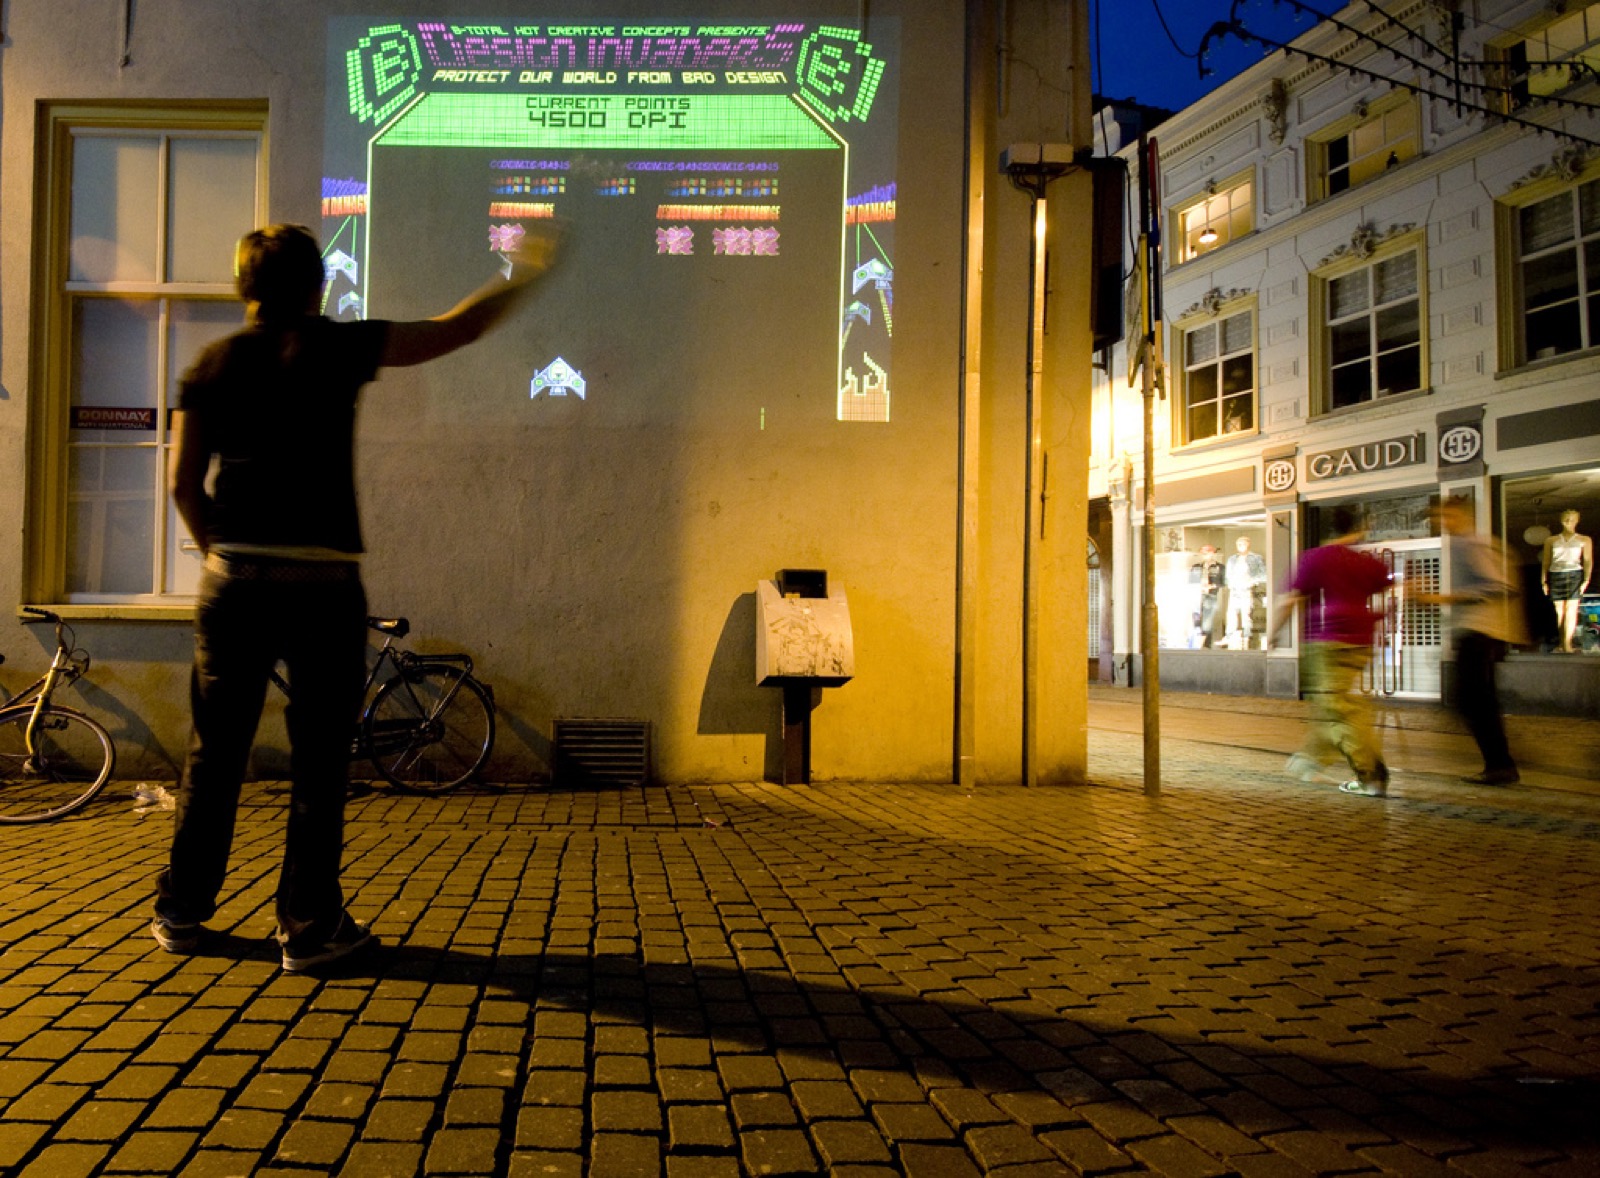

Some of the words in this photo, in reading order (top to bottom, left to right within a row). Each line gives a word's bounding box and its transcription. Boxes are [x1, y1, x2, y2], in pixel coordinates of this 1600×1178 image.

[514, 25, 540, 36] HOT
[547, 25, 615, 36] CREATIVE
[622, 26, 692, 36] CONCEPTS
[432, 69, 511, 83] PROTECT
[519, 70, 553, 83] OUR
[562, 71, 617, 84] WORLD
[628, 71, 672, 84] FROM
[681, 71, 716, 84] BAD
[725, 71, 788, 84] DESIGN
[526, 96, 612, 109] CURRENT
[625, 97, 691, 110] POINTS
[529, 110, 607, 128] 4500
[628, 111, 687, 129] DPI
[78, 409, 149, 421] DONNAY
